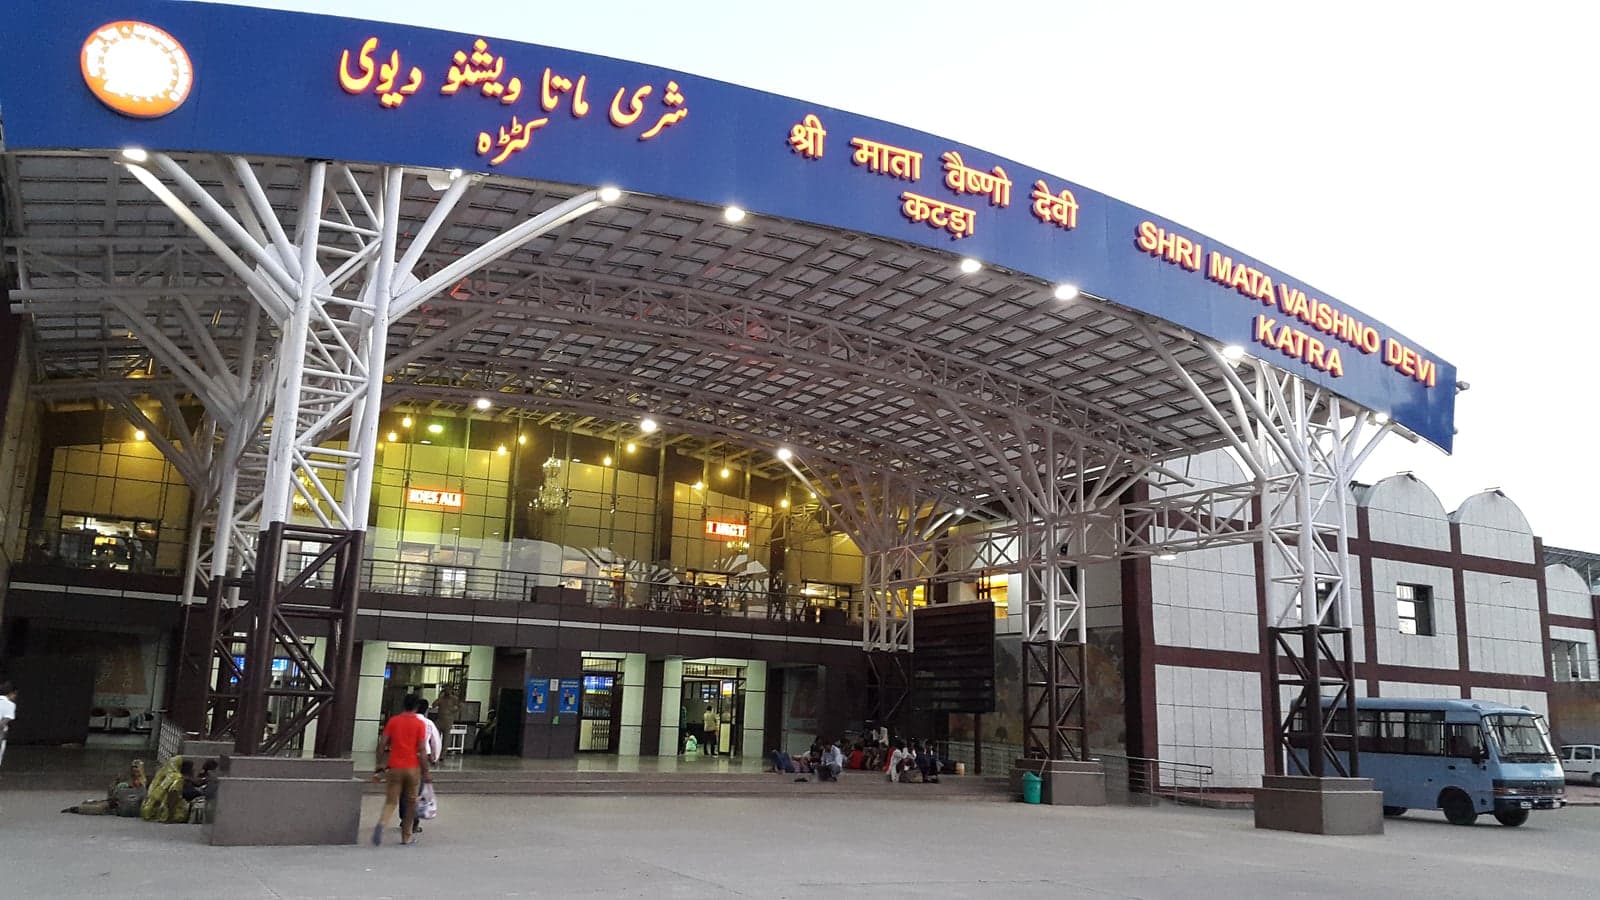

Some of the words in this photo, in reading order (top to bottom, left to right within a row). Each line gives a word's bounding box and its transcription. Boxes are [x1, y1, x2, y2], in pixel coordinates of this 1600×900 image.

[338, 36, 424, 108] دیوی
[440, 38, 522, 104] ویشنو
[540, 67, 590, 117] ماتا
[608, 81, 689, 140] شری
[788, 114, 827, 158] श्री
[850, 136, 923, 180] माता
[942, 151, 1012, 207] वैष्णो
[1031, 179, 1079, 229] देवी
[900, 191, 976, 240] कटड़ा
[1135, 220, 1202, 271] SHRI
[1206, 250, 1276, 305] MATA
[1278, 281, 1380, 355] VAISHNO
[1382, 337, 1437, 388] DEVI
[1252, 313, 1344, 378] KATRA
